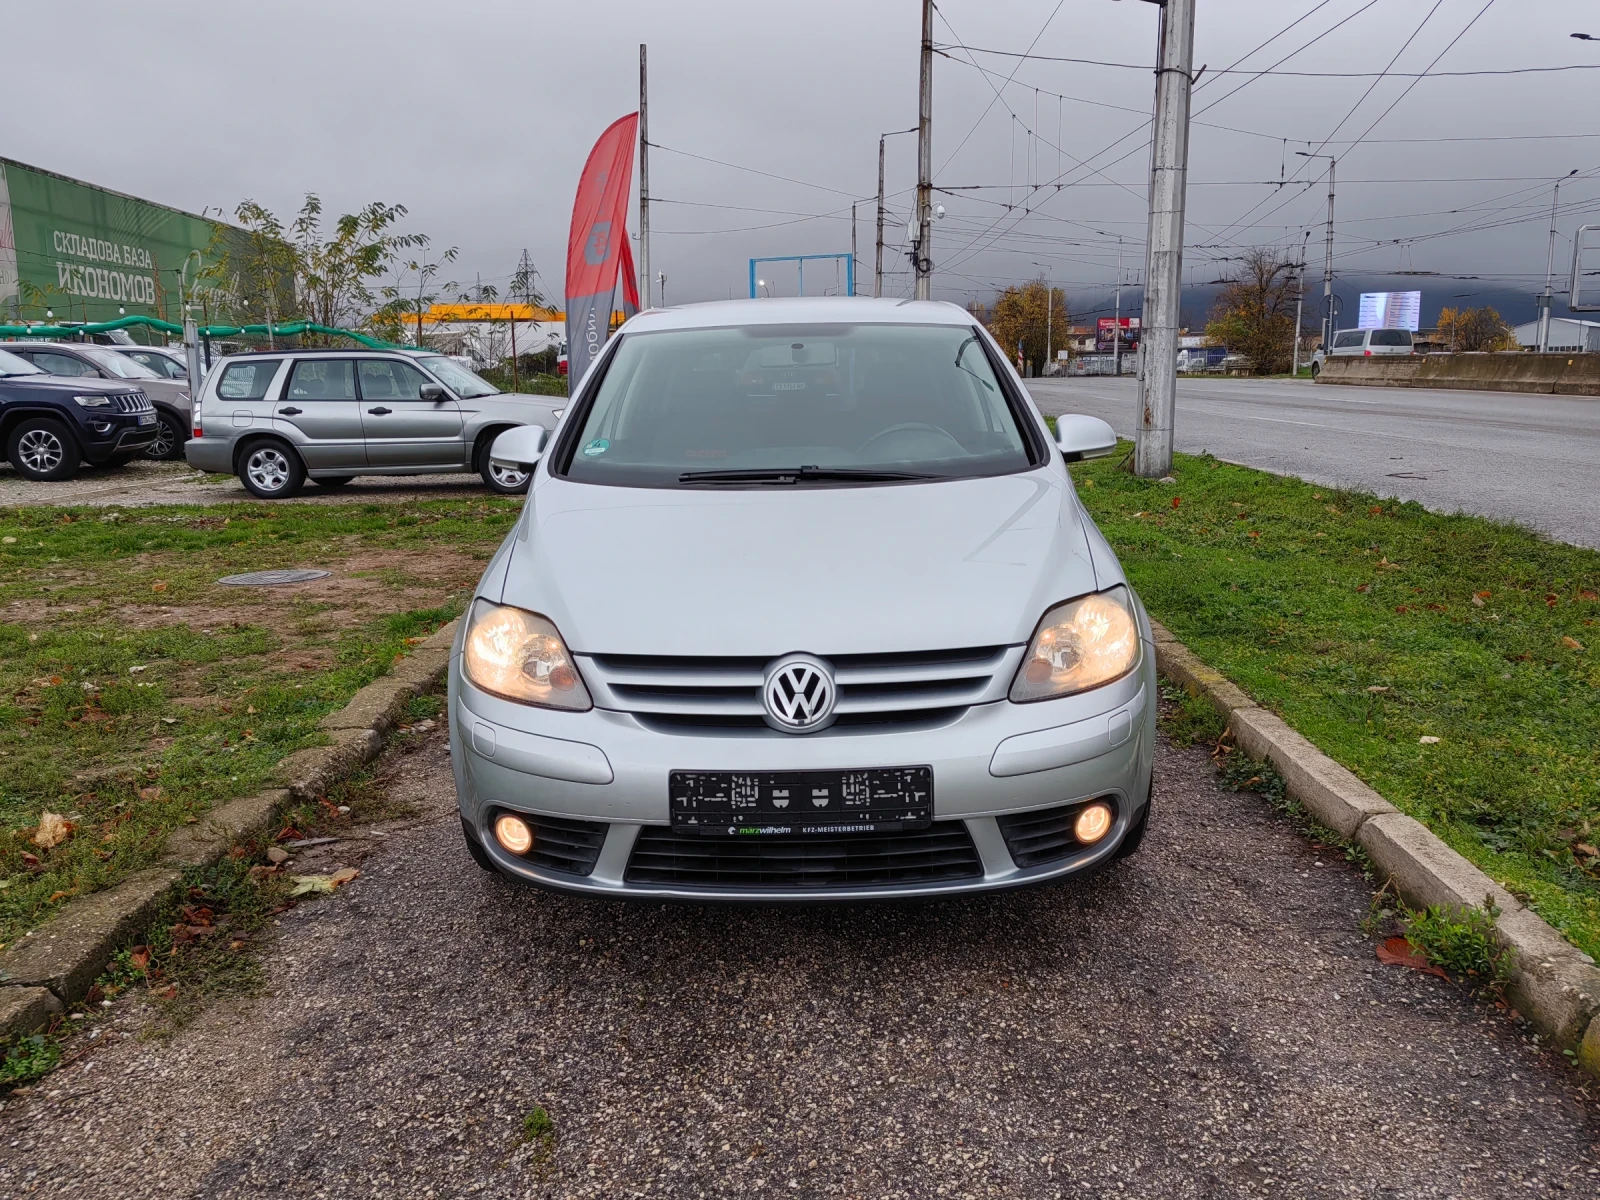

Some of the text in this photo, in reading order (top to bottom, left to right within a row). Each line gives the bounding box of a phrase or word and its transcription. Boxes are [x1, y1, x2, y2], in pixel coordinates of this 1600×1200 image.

[53, 230, 153, 269] СКЛАДОВА БАЗА
[56, 262, 156, 305] ИКОНОМОВ
[769, 664, 830, 726] VW
[739, 824, 875, 835] märzwilhelm KFZ-MEISTERBETRIEB
